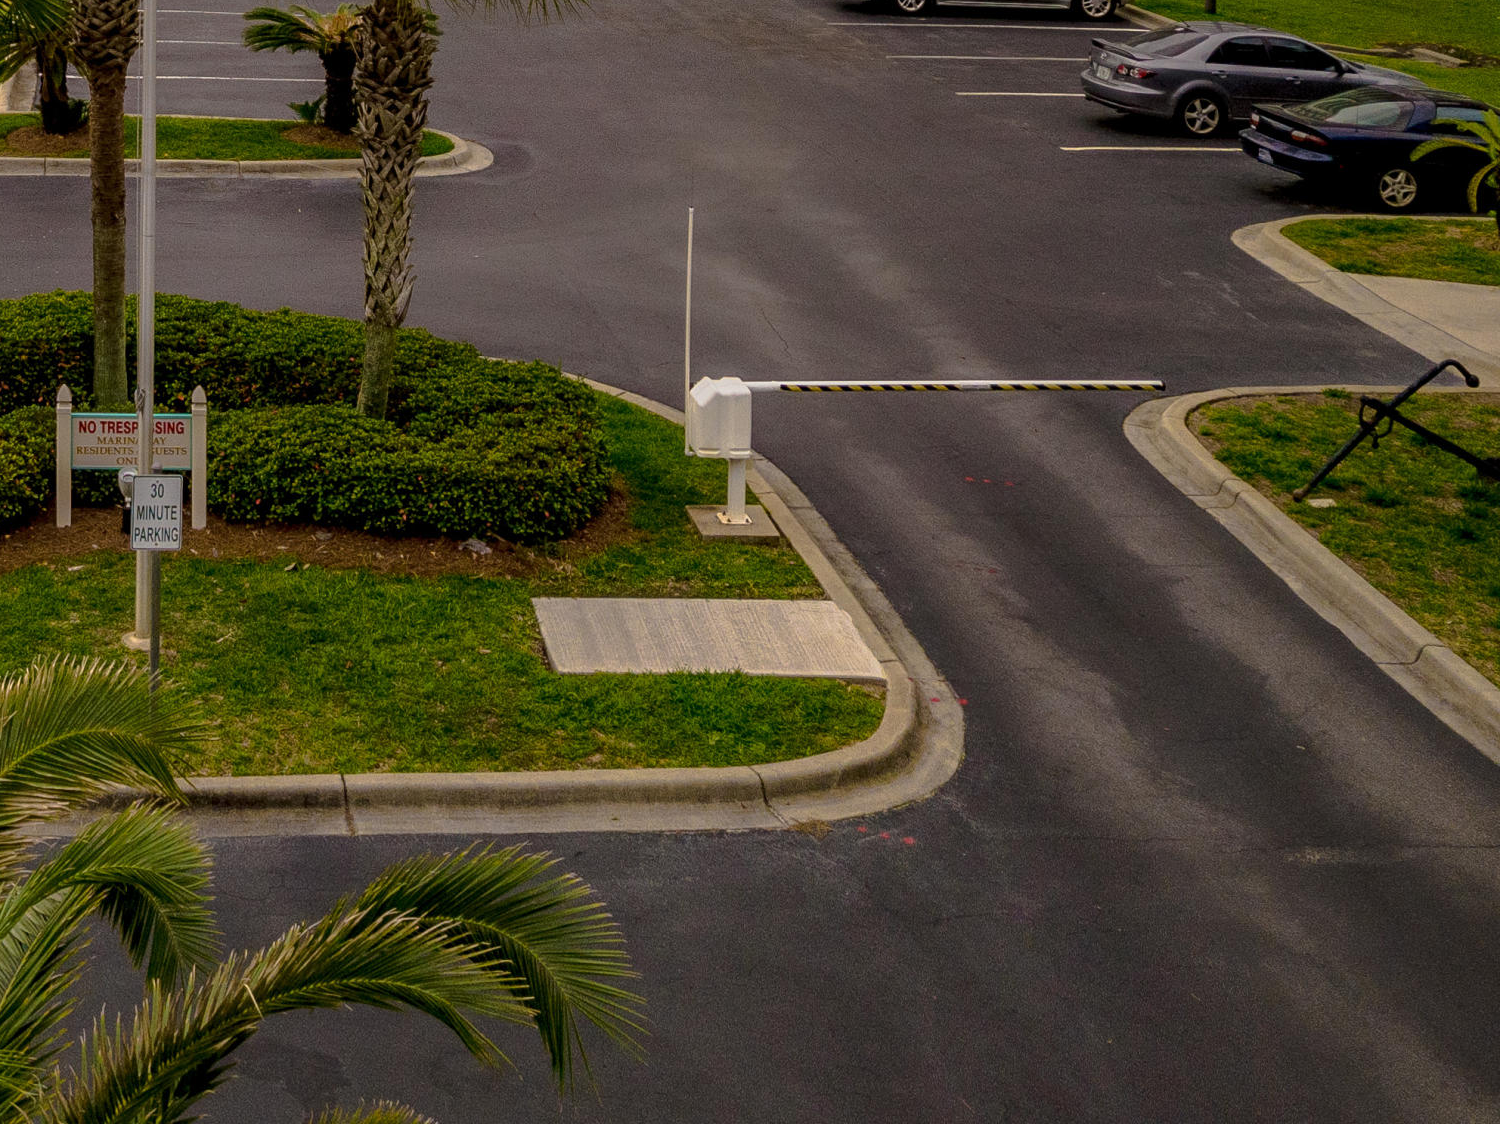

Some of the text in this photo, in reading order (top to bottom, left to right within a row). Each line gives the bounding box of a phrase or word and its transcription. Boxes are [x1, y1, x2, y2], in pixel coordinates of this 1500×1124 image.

[79, 420, 185, 434] NO TRESPSING
[77, 447, 134, 455] RESIDENTS
[116, 457, 139, 465] ONL
[151, 483, 164, 498] 30
[136, 505, 177, 520] MINUTE
[134, 527, 178, 542] PARKING
